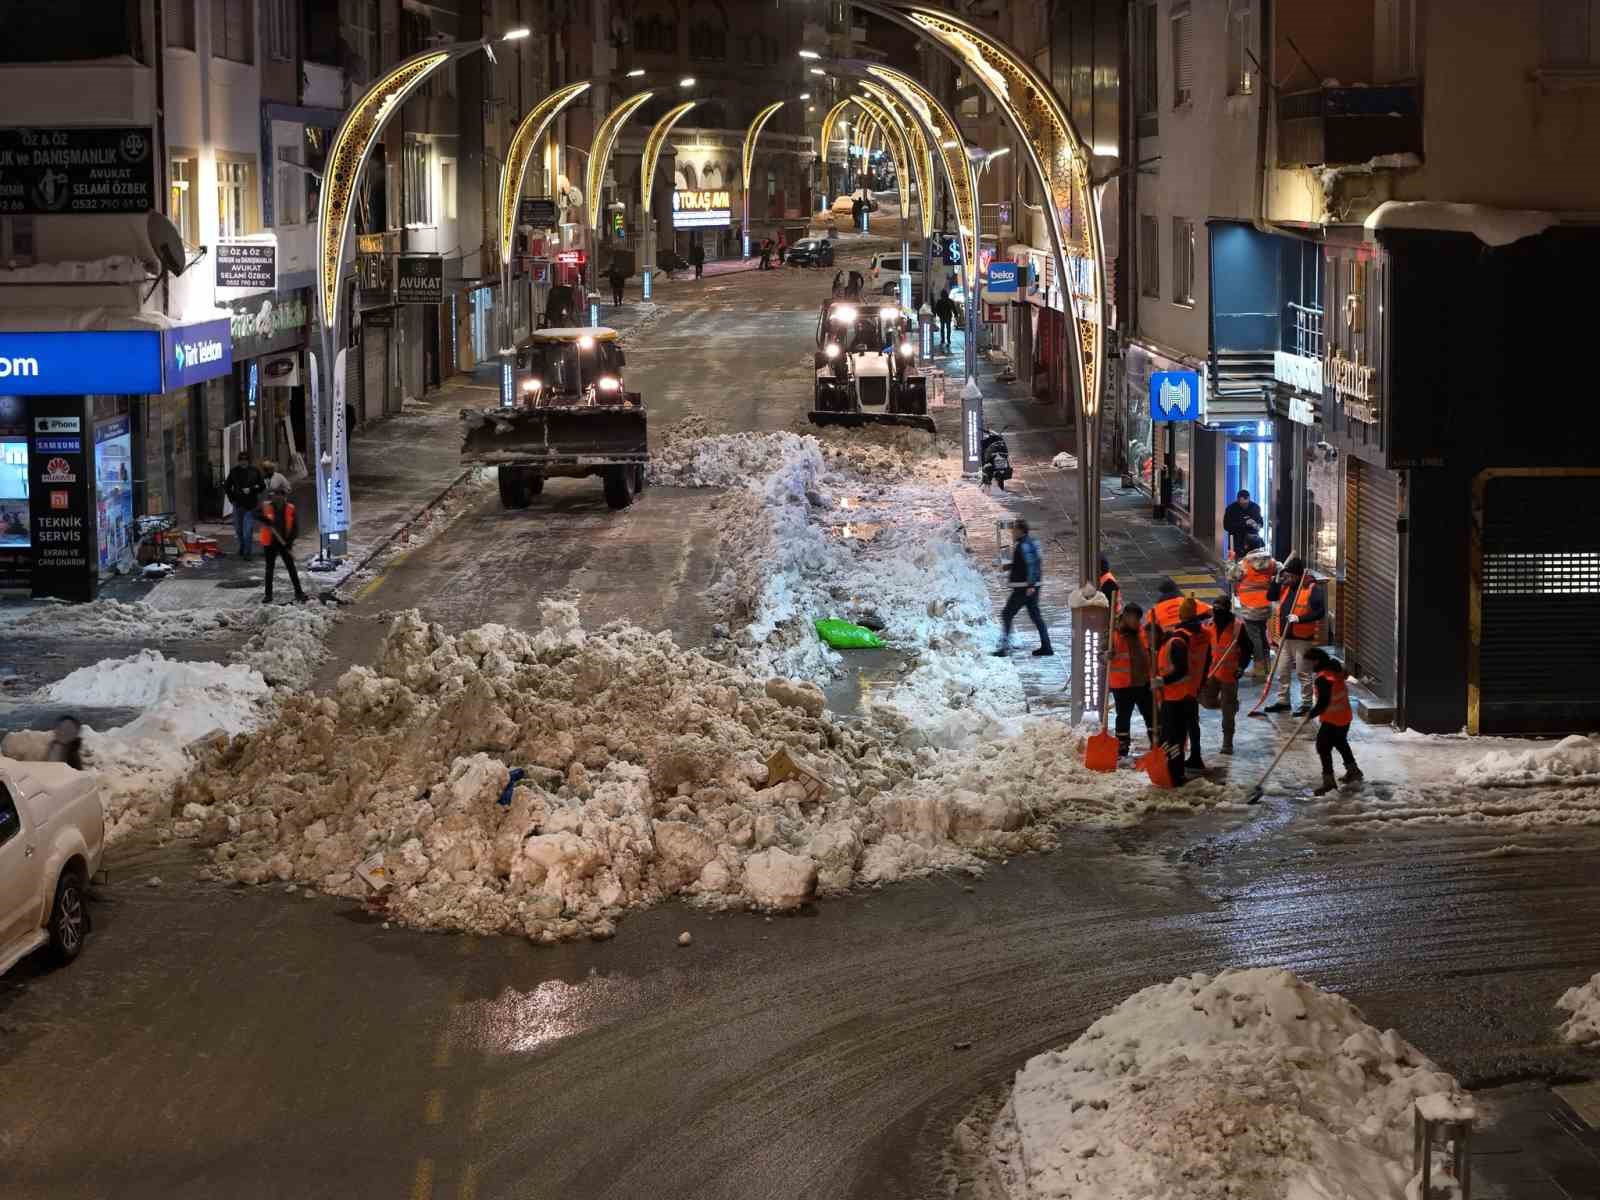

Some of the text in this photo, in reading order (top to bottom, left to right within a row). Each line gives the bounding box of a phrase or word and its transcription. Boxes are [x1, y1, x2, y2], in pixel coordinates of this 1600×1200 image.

[88, 168, 131, 180] AVUKAT
[72, 180, 146, 196] SELAMİ ÖZBEK
[991, 270, 1014, 280] beko
[399, 276, 441, 289] AVUKAT
[199, 340, 223, 364] Telekom
[37, 440, 80, 449] SAMSUNG
[38, 514, 81, 528] TEKNİK
[40, 530, 81, 542] SERVİS
